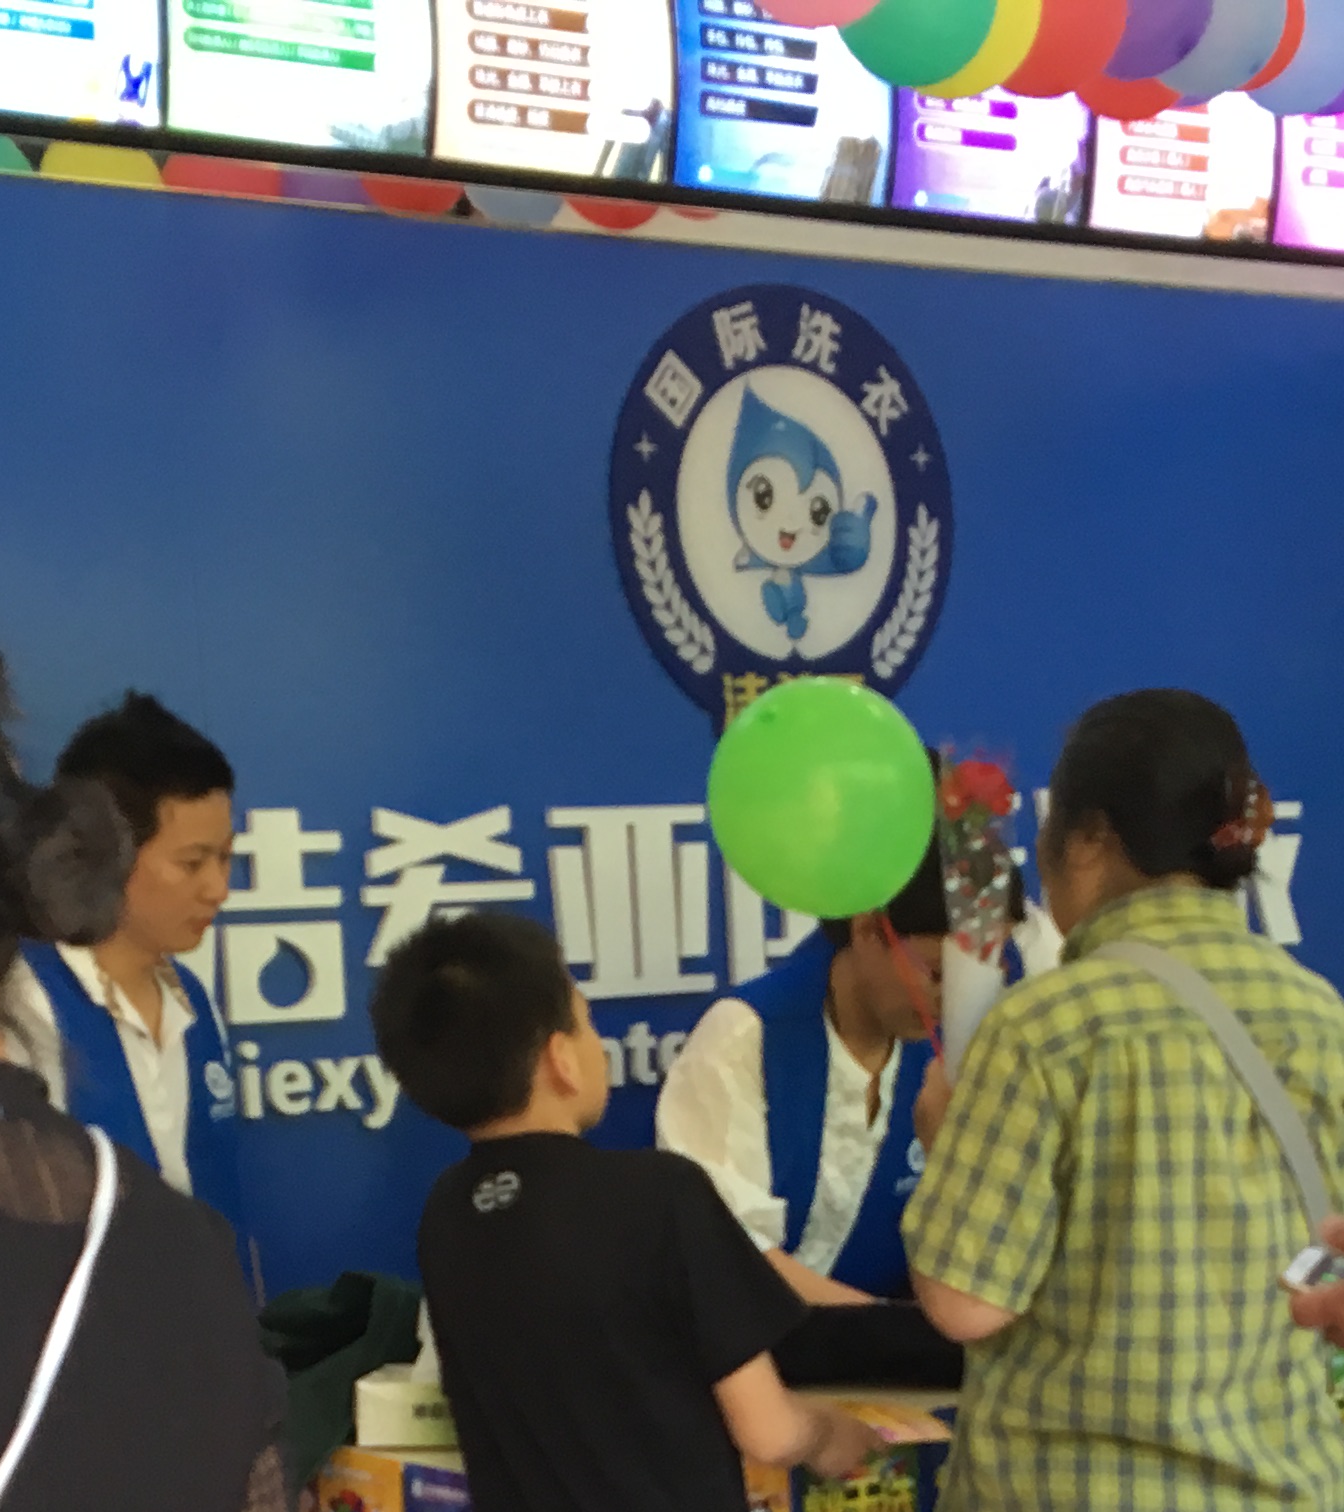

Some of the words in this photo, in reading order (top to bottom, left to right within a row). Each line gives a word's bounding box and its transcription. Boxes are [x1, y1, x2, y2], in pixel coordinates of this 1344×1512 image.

[643, 300, 910, 437] 国际洗衣
[236, 1040, 402, 1130] iexy
